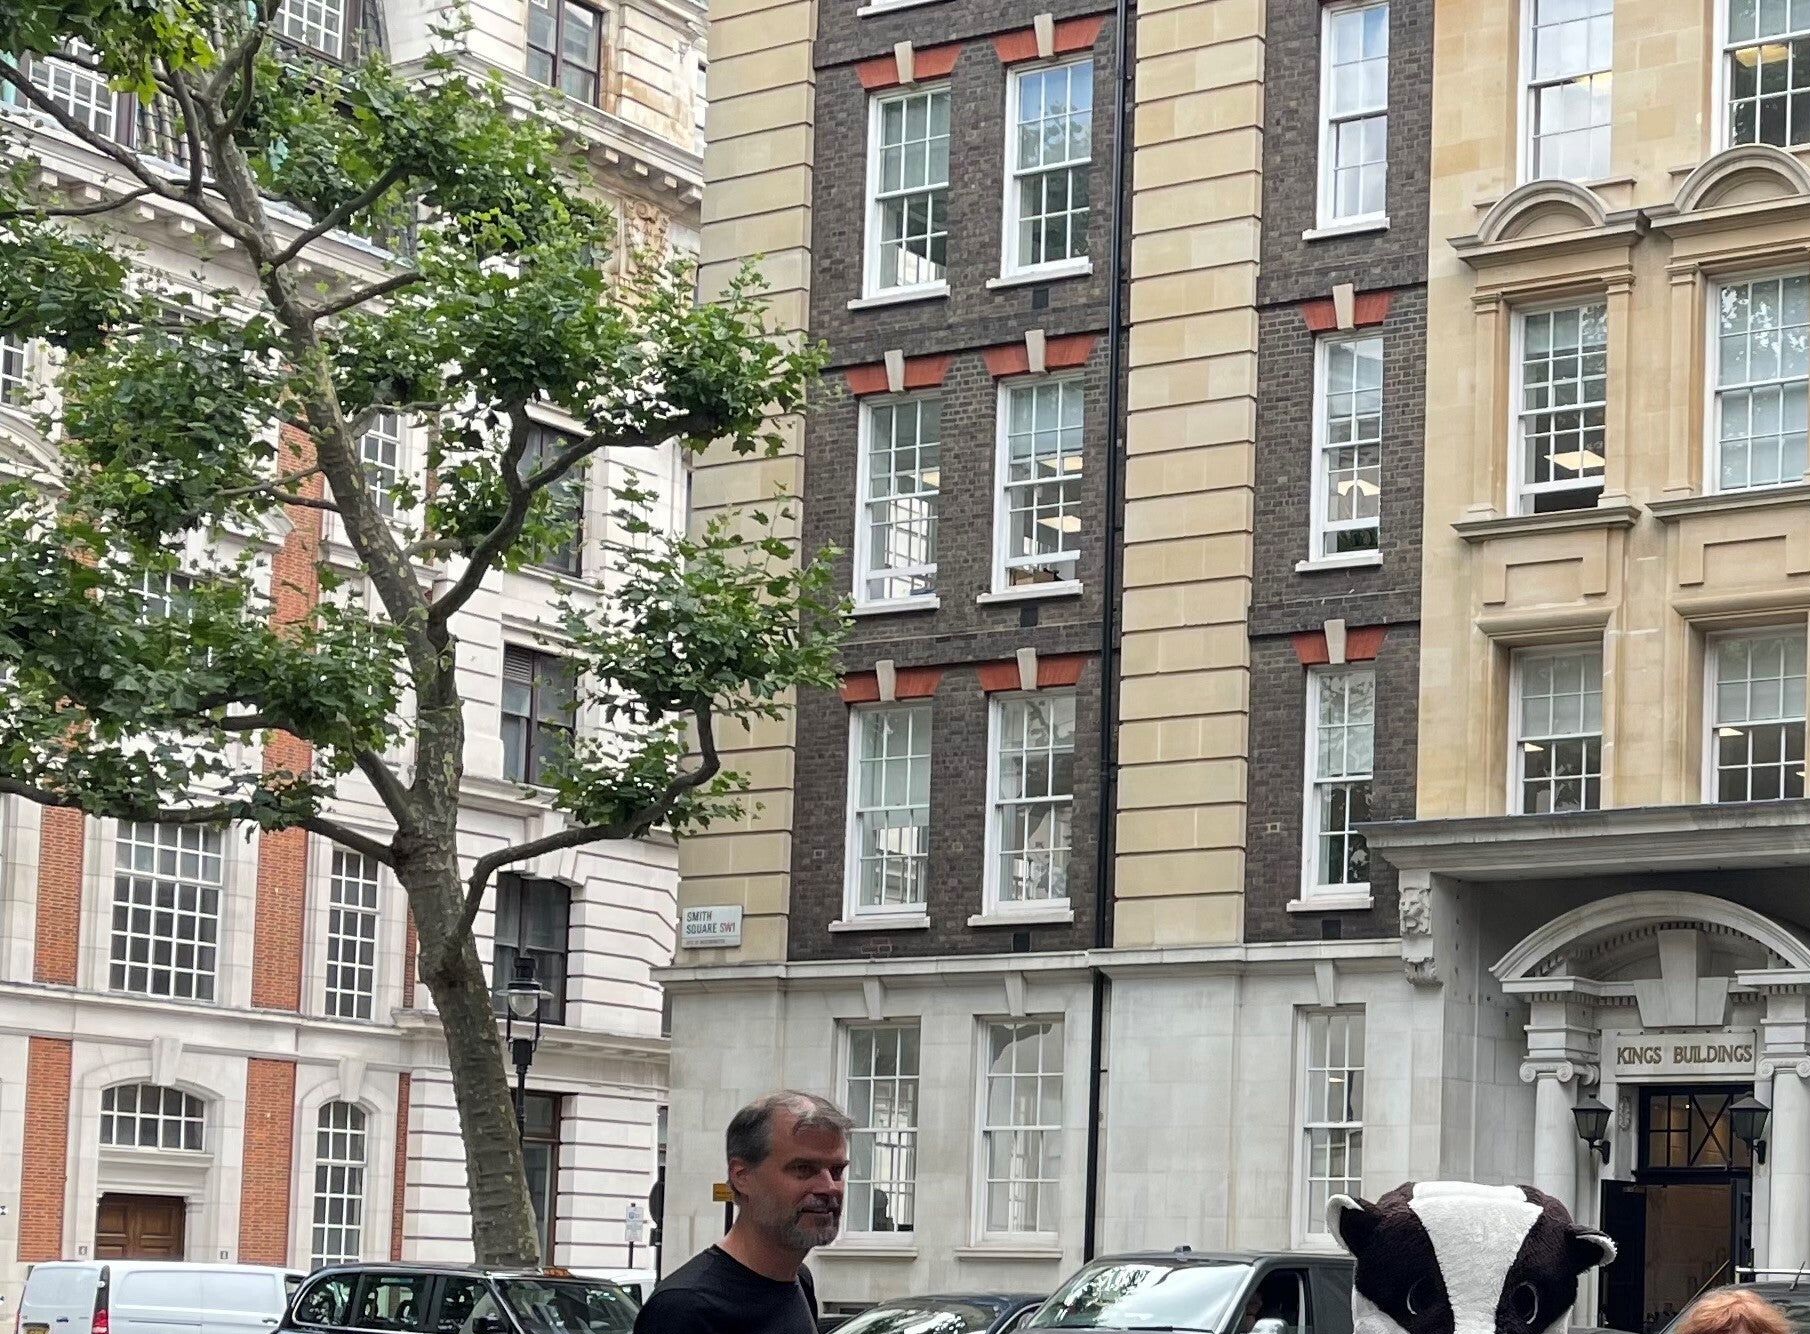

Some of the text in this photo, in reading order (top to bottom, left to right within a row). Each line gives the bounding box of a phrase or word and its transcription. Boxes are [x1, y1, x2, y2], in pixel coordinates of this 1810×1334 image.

[687, 911, 712, 922] SMITH
[686, 922, 736, 934] SQUARE SW1
[1616, 1044, 1752, 1065] KINGS BUILDINGS
